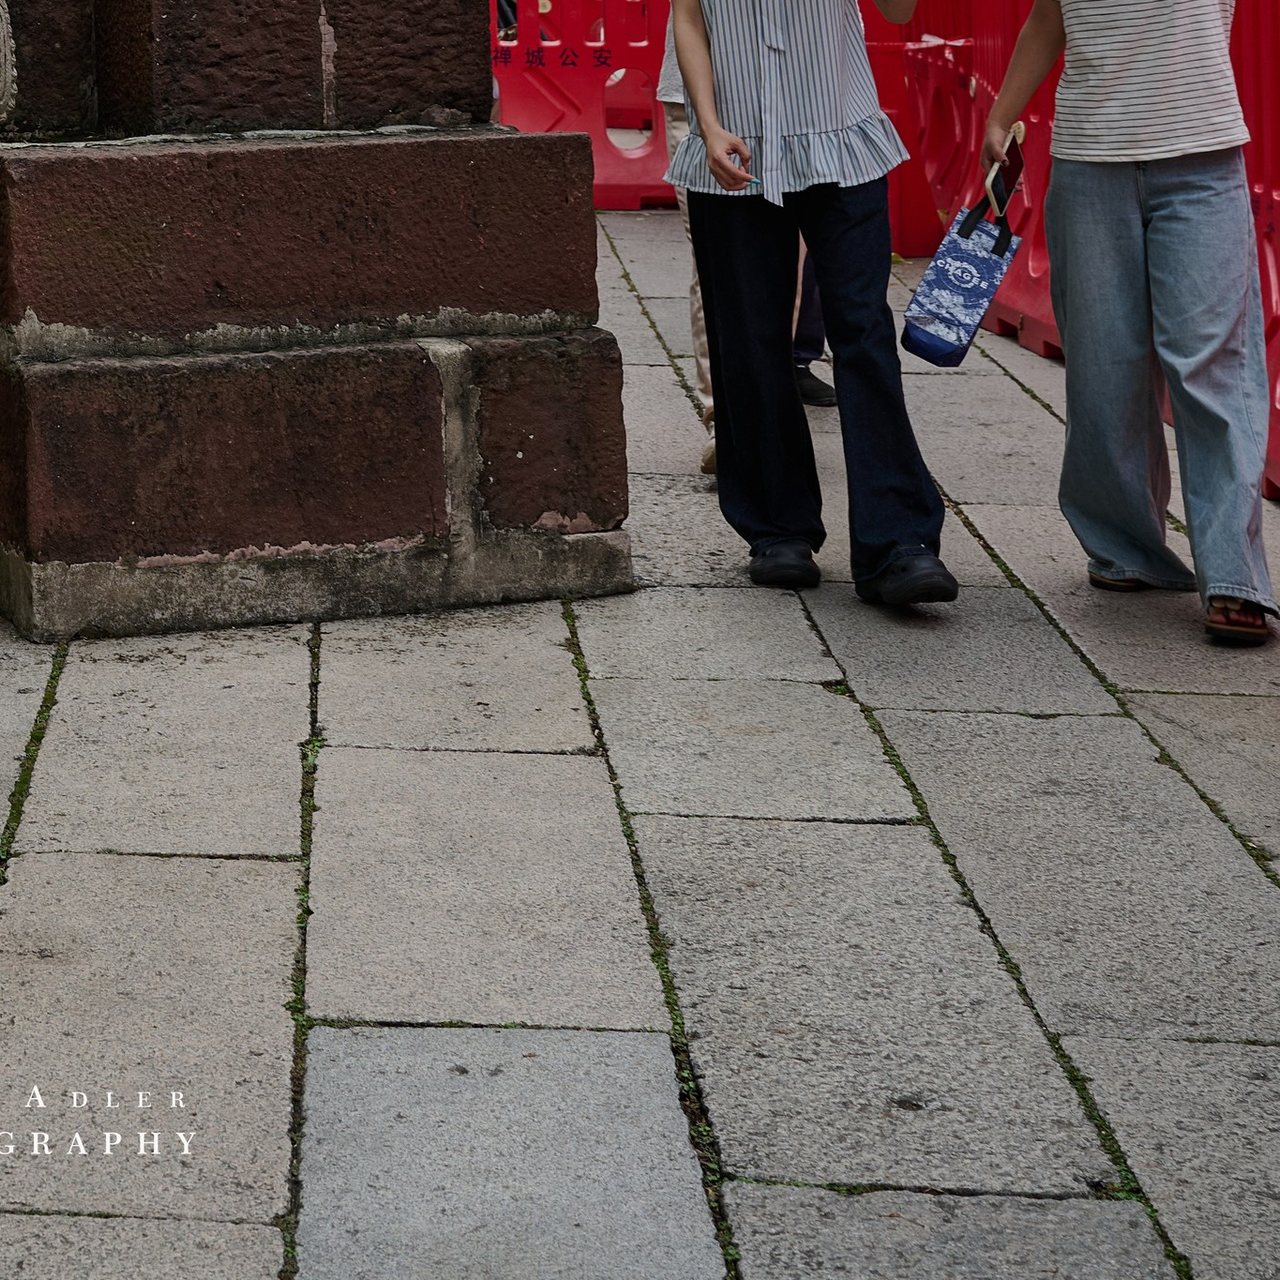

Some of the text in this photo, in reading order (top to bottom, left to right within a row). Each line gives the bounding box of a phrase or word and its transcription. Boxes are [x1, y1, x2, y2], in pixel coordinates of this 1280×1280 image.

[492, 47, 613, 68] 禅城公安
[936, 259, 990, 290] CHAGEE
